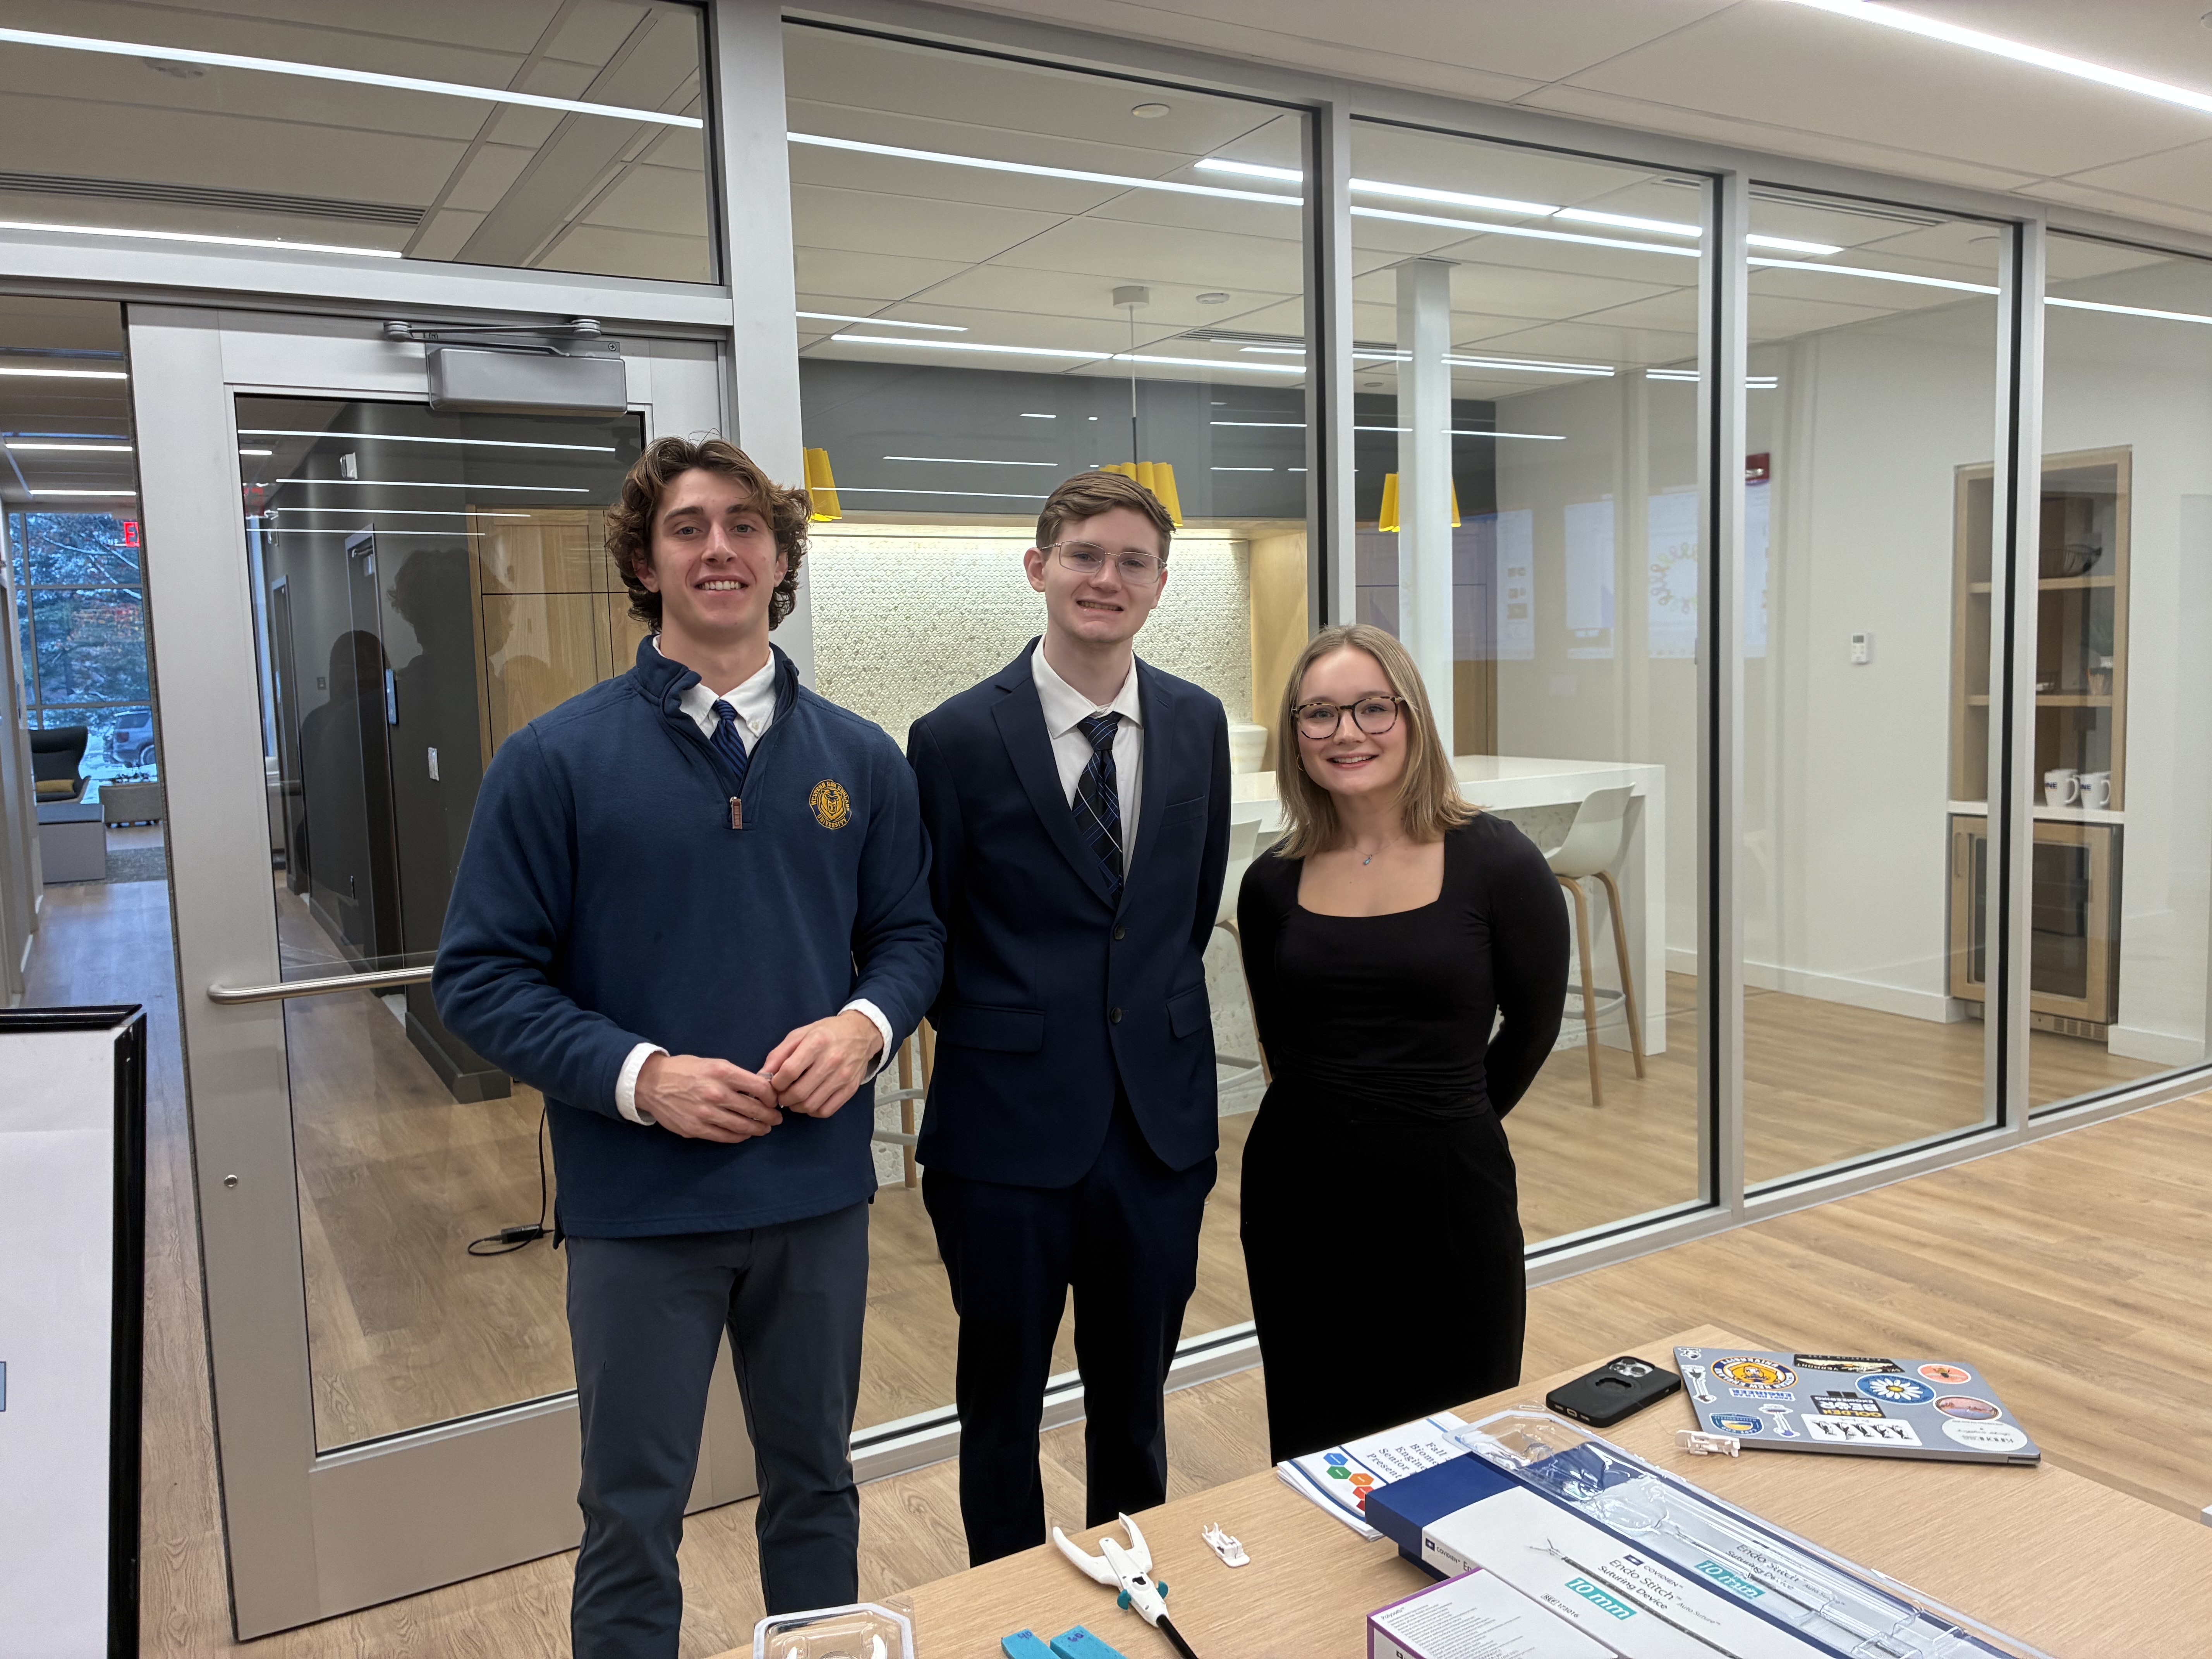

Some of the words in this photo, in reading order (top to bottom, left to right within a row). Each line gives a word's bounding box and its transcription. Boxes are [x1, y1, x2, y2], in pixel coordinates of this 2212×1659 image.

[811, 781, 826, 805] WESTERN
[817, 814, 847, 828] UNIVERSITY
[1379, 1448, 1410, 1470] Senior
[1395, 1446, 1427, 1470] Engine
[1410, 1444, 1439, 1465] Biome
[1425, 1442, 1447, 1456] Fall
[1366, 1453, 1403, 1480] Present
[1736, 1544, 1766, 1563] Endo
[1609, 1559, 1640, 1579] Endo
[1697, 1563, 1723, 1575] 10
[1598, 1565, 1636, 1590] Suturing
[1636, 1588, 1667, 1609] Device
[1568, 1579, 1594, 1593] 10
[1589, 1594, 1630, 1618] mm
